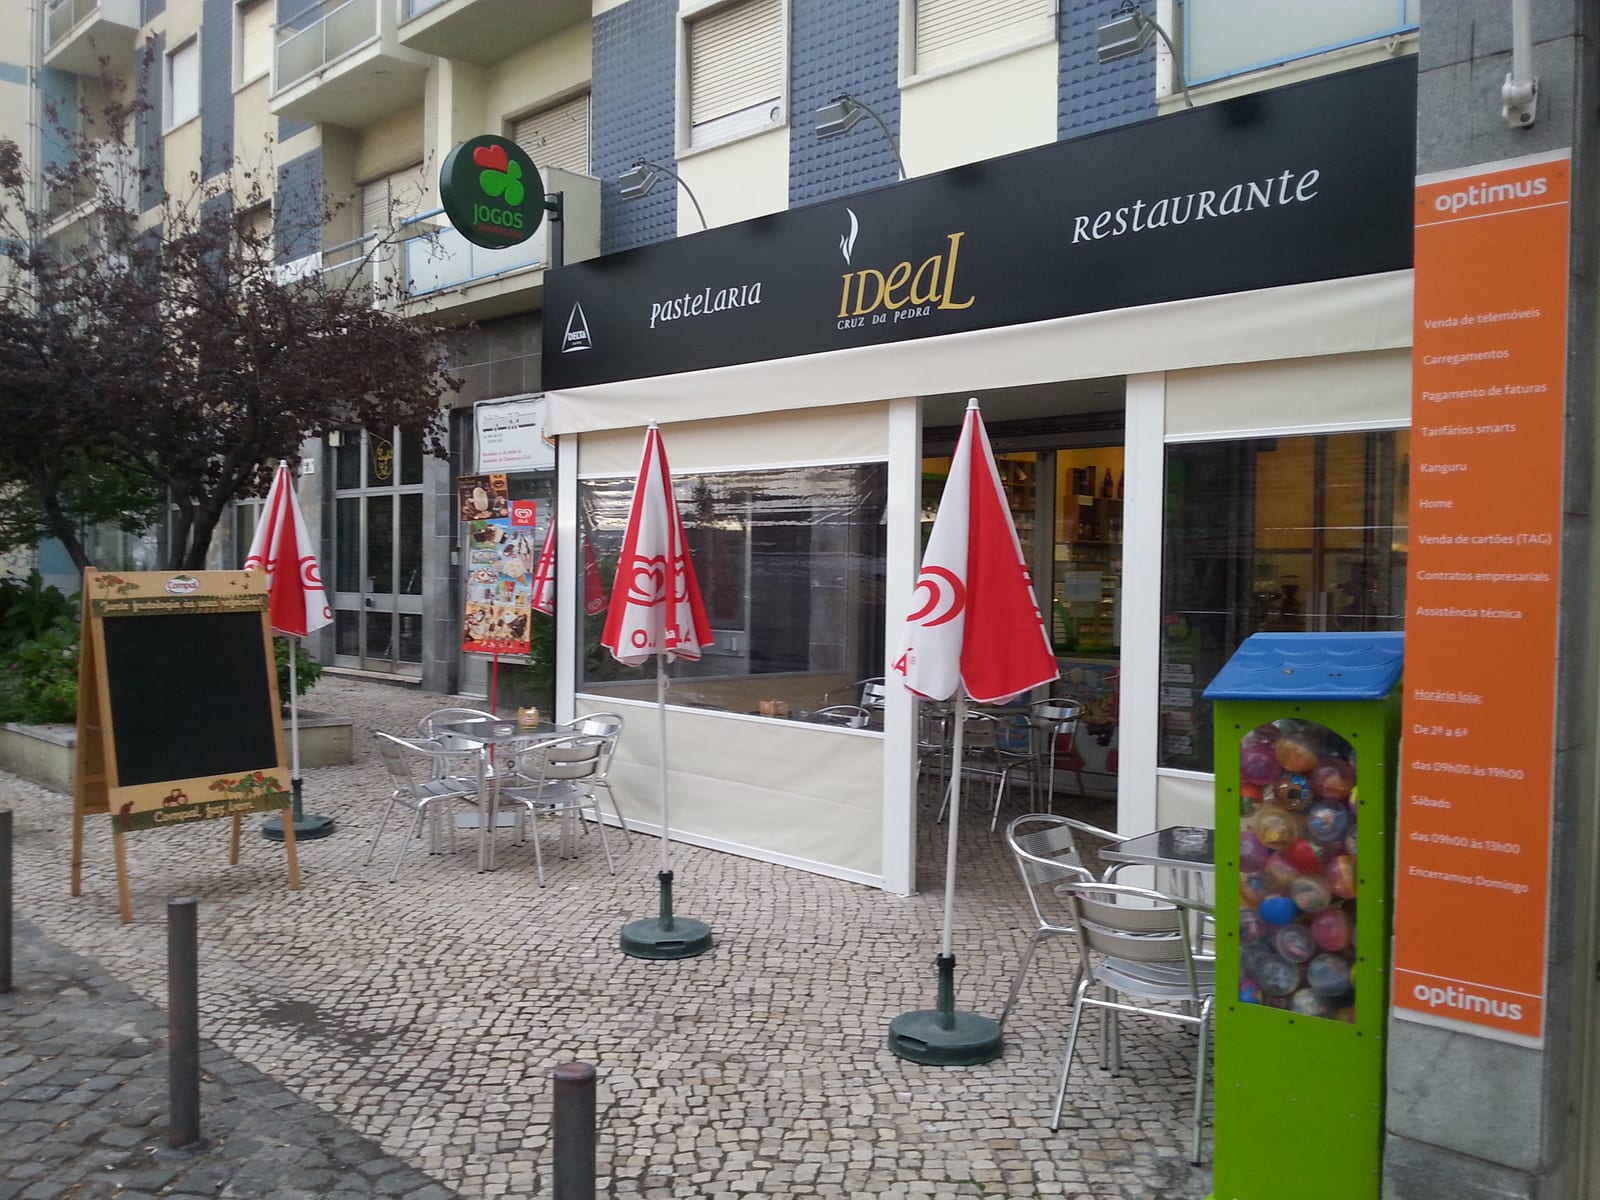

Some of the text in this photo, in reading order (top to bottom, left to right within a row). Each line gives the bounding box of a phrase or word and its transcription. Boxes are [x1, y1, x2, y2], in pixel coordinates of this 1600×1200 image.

[1434, 177, 1548, 214] optimus
[472, 203, 524, 229] JOGOS
[837, 317, 865, 330] CRUZ
[1424, 308, 1541, 329] Venda de telemóveis
[1423, 349, 1510, 366] Carregamentos
[1422, 383, 1548, 403] Pagamento de faturas
[1422, 422, 1517, 437] Tarifários smarts
[1420, 463, 1468, 475] Kanguru
[1419, 499, 1454, 509] Home
[1417, 533, 1553, 546] Venda de cartões (TAG)
[1416, 570, 1550, 583] Contratos empresariais
[1416, 606, 1523, 619] Assistência técnica
[1414, 689, 1457, 701] Horário
[1413, 724, 1430, 735] De
[1445, 728, 1453, 737] a
[1411, 760, 1524, 780] das 09h00 às 19h00
[1410, 794, 1452, 809] Sábado
[1410, 831, 1521, 854] das 09h00 às 13h00
[1408, 865, 1530, 894] Encerramos Domingo
[1413, 984, 1523, 1021] optimus
